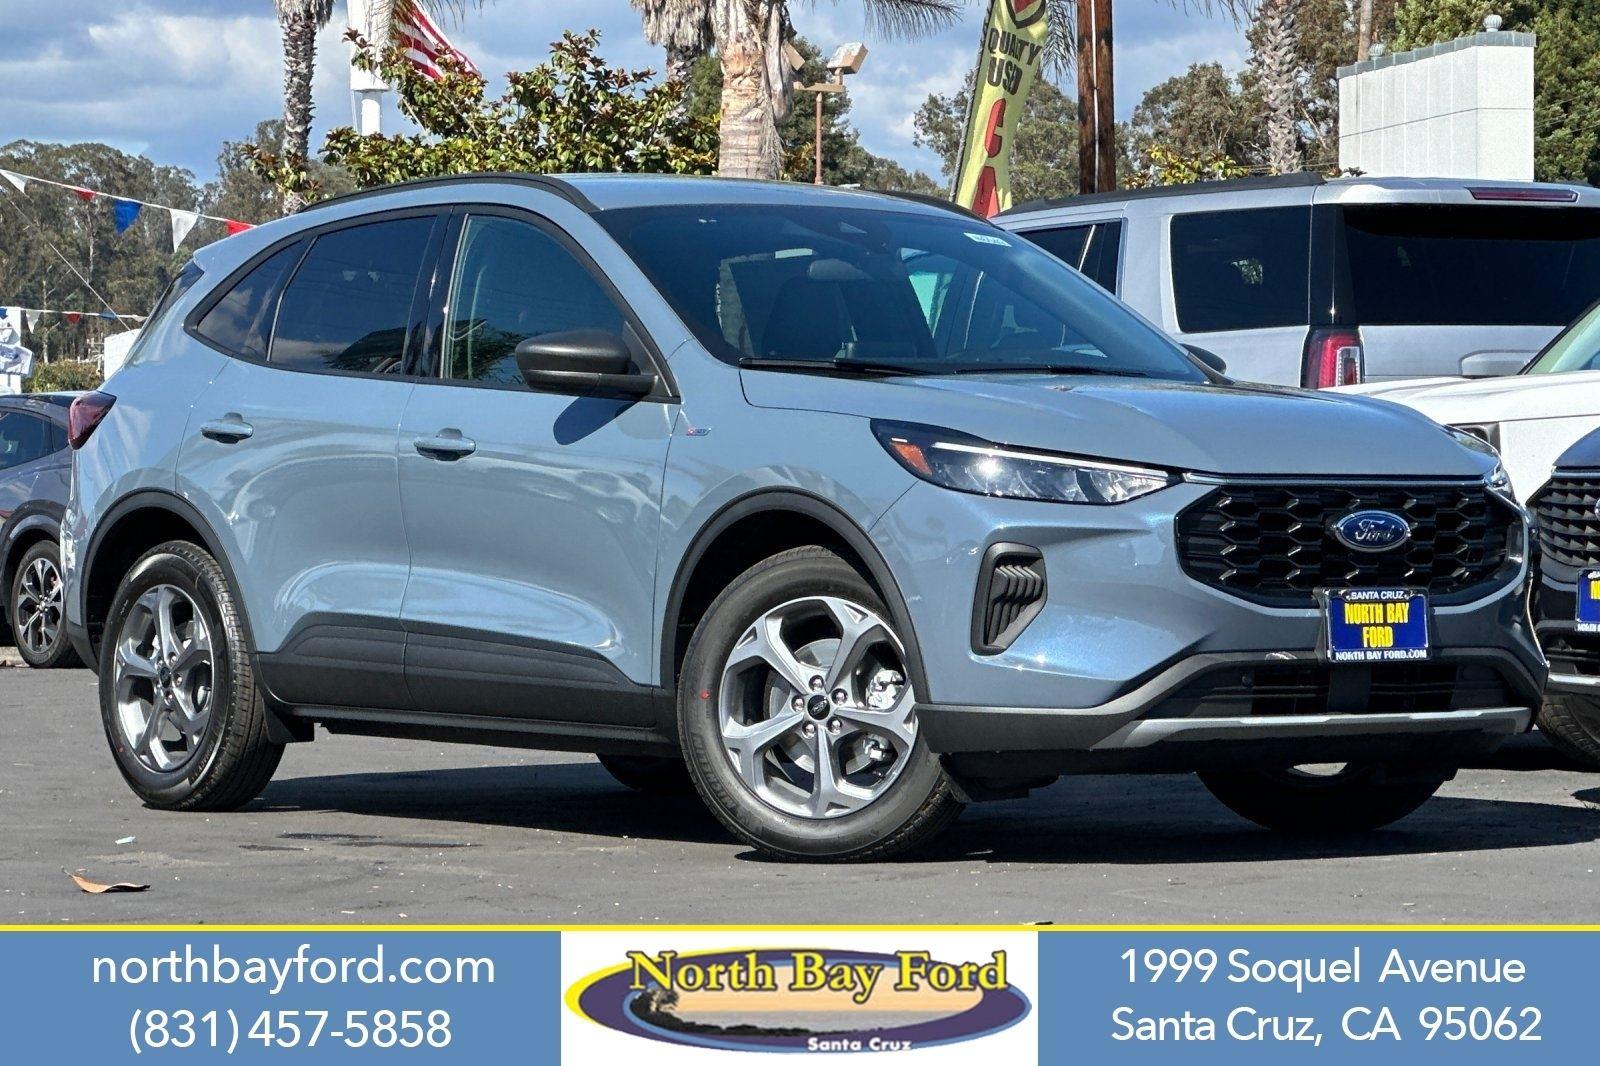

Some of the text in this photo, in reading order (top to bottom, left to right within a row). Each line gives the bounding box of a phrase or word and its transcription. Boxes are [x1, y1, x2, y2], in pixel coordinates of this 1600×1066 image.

[1355, 518, 1396, 541] Ford
[1350, 591, 1404, 600] SANTA CRUZ
[1344, 602, 1409, 624] NORTH BAY
[1363, 626, 1394, 648] FORD
[1335, 651, 1365, 660] NORTH
[1366, 650, 1382, 660] BAY
